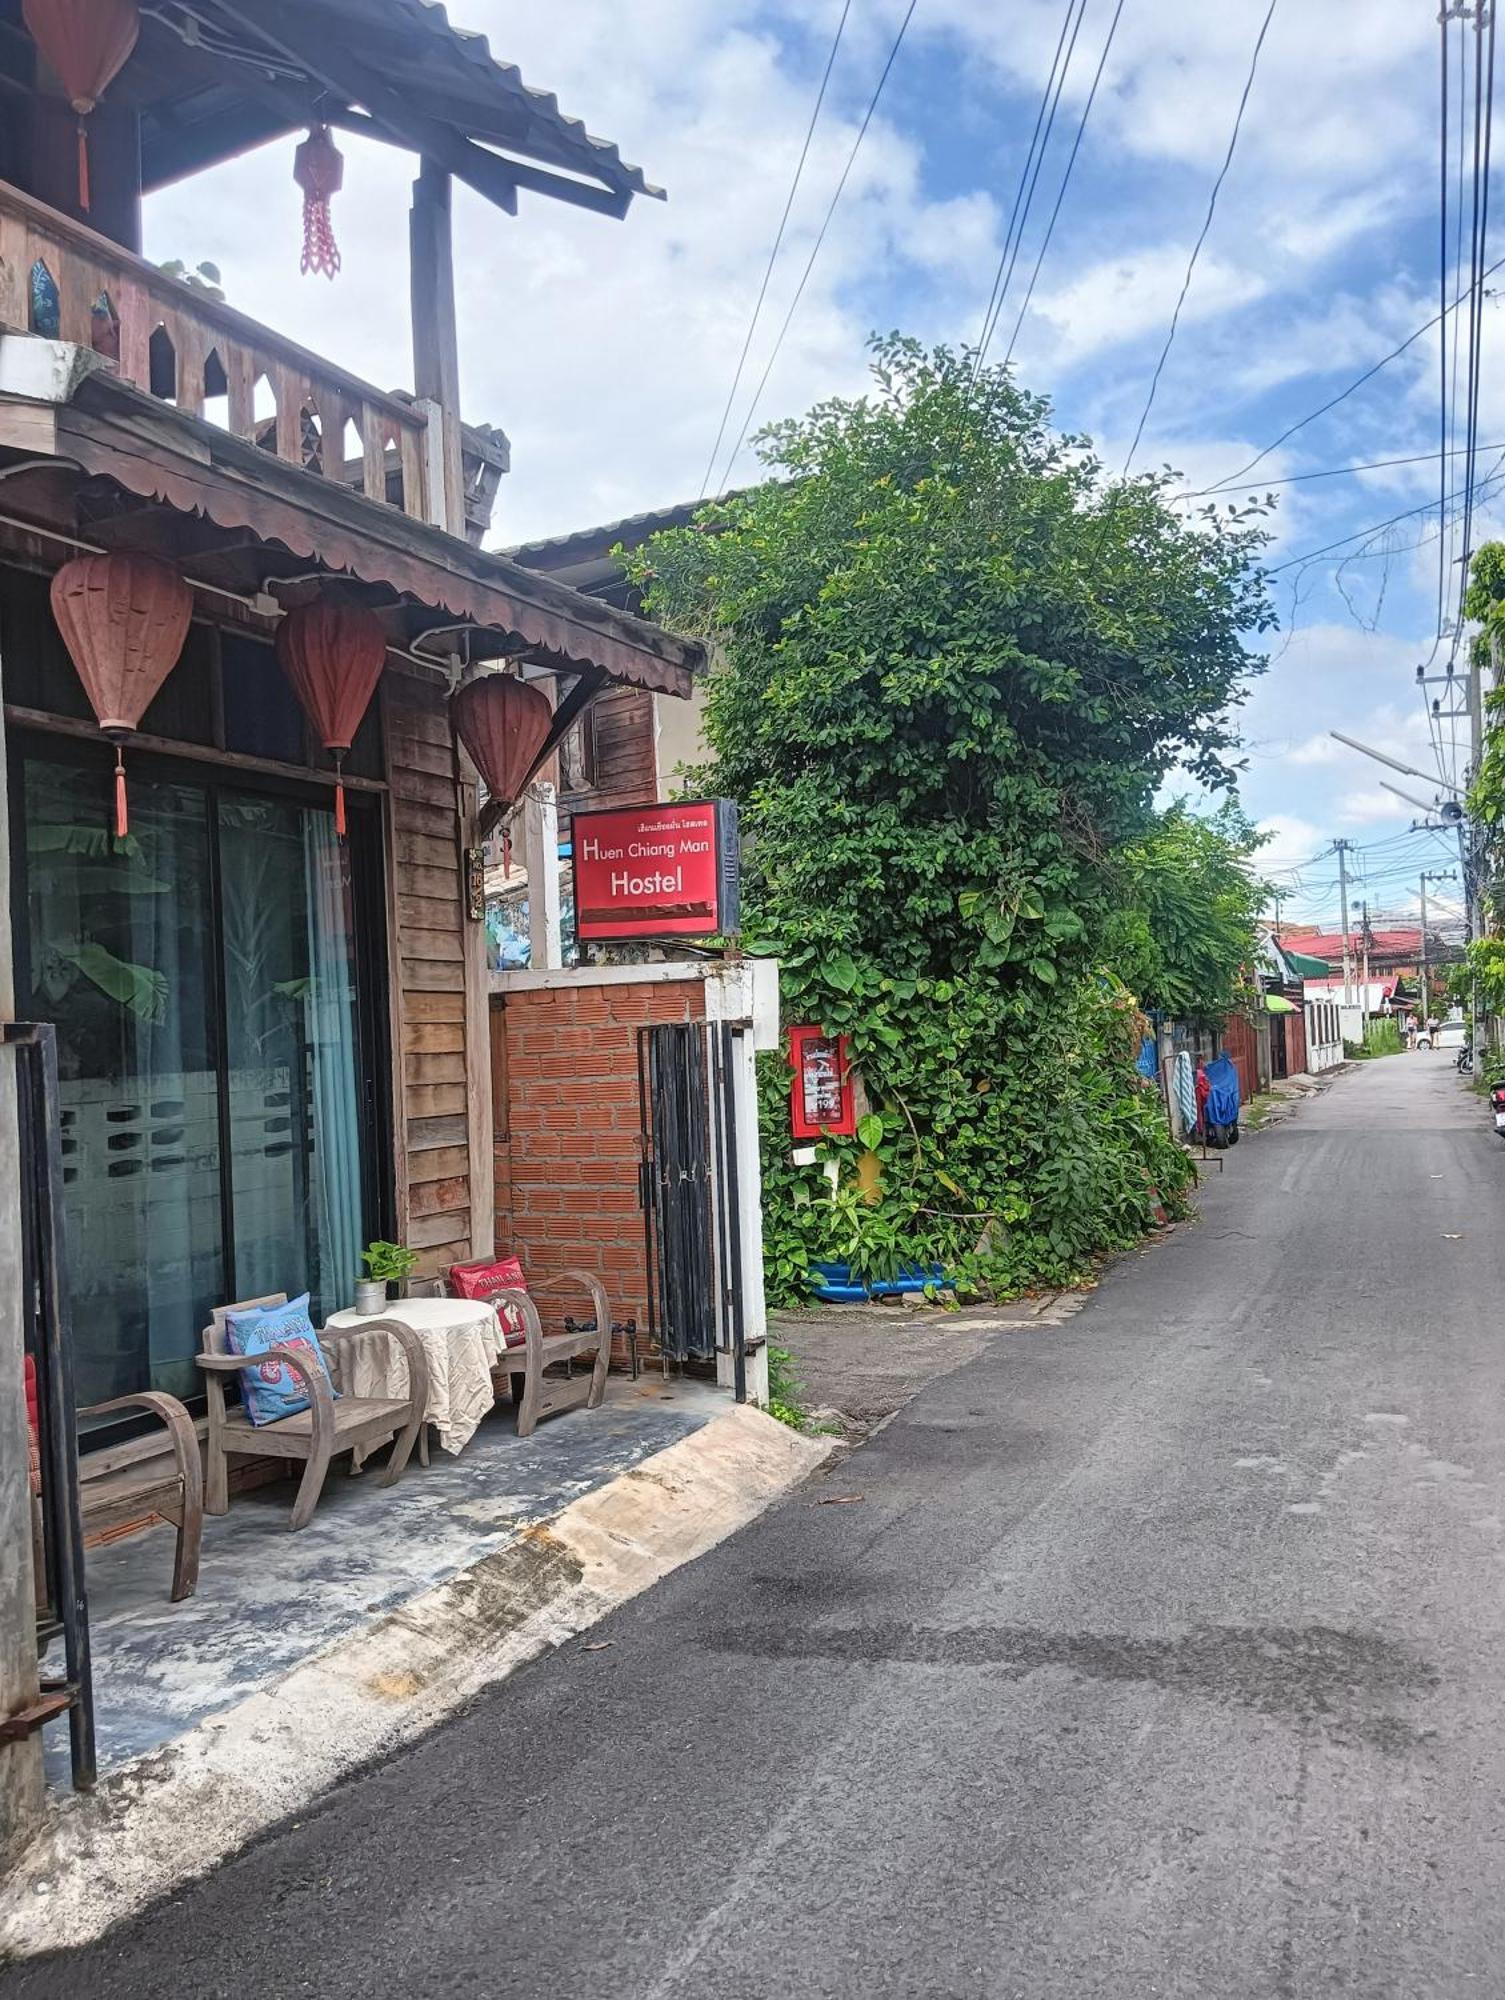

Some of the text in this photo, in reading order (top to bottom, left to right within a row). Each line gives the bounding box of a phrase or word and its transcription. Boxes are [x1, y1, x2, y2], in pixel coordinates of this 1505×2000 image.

[583, 838, 709, 861] Huen Chiang Man
[611, 865, 682, 896] Hostel
